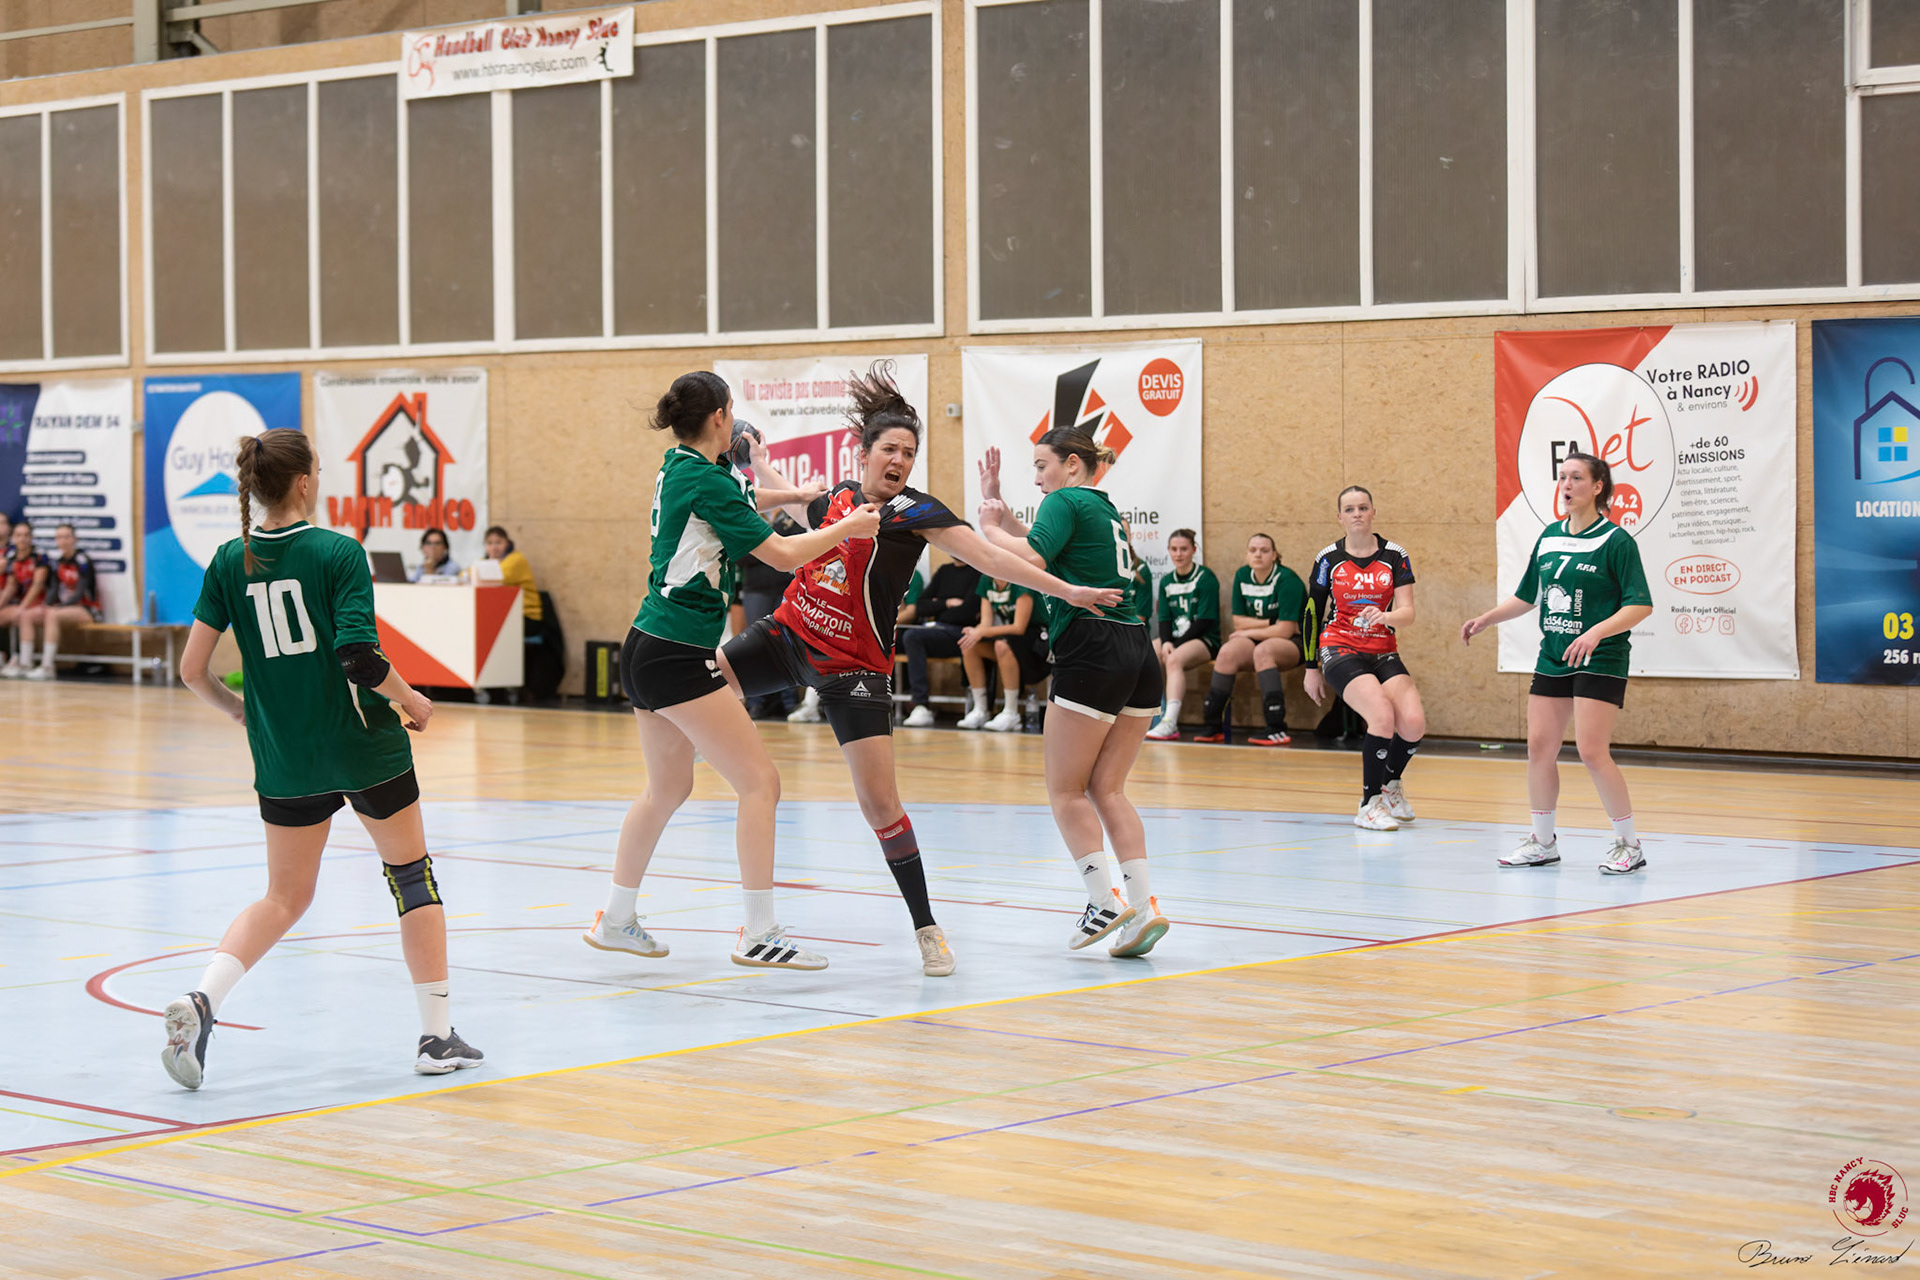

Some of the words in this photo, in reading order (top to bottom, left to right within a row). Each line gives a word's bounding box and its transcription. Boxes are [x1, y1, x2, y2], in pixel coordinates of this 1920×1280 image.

[501, 27, 532, 50] Club
[451, 55, 588, 81] www.hbcnancysluc.com
[1646, 368, 1692, 384] Votre
[1697, 359, 1750, 380] RADIO
[1142, 373, 1181, 389] DEVIS
[743, 380, 755, 401] Un
[758, 379, 792, 401] caviste
[1142, 389, 1181, 401] GRATUIT
[1667, 386, 1677, 400] à
[1683, 384, 1731, 399] Nancy
[1677, 402, 1684, 412] &
[1688, 400, 1728, 412] environs
[1714, 435, 1729, 447] 60
[171, 447, 204, 475] Guy
[1678, 448, 1746, 465] ÉMISSIONS
[1623, 516, 1637, 526] FM
[1554, 555, 1572, 579] 7
[1680, 565, 1693, 574] EN
[1696, 562, 1727, 573] DIRECT
[1352, 572, 1375, 591] 24
[1674, 576, 1687, 585] EN
[1690, 573, 1731, 584] PODCAST
[816, 598, 828, 609] LE
[1178, 595, 1189, 613] 4
[1343, 592, 1357, 600] Guy
[1573, 588, 1583, 617] LUDRES
[1253, 599, 1264, 616] 9
[1671, 605, 1691, 613] Radio
[1693, 606, 1712, 616] Fajet
[245, 577, 318, 659] 10
[1883, 612, 1914, 640] 03
[1883, 649, 1909, 664] 256
